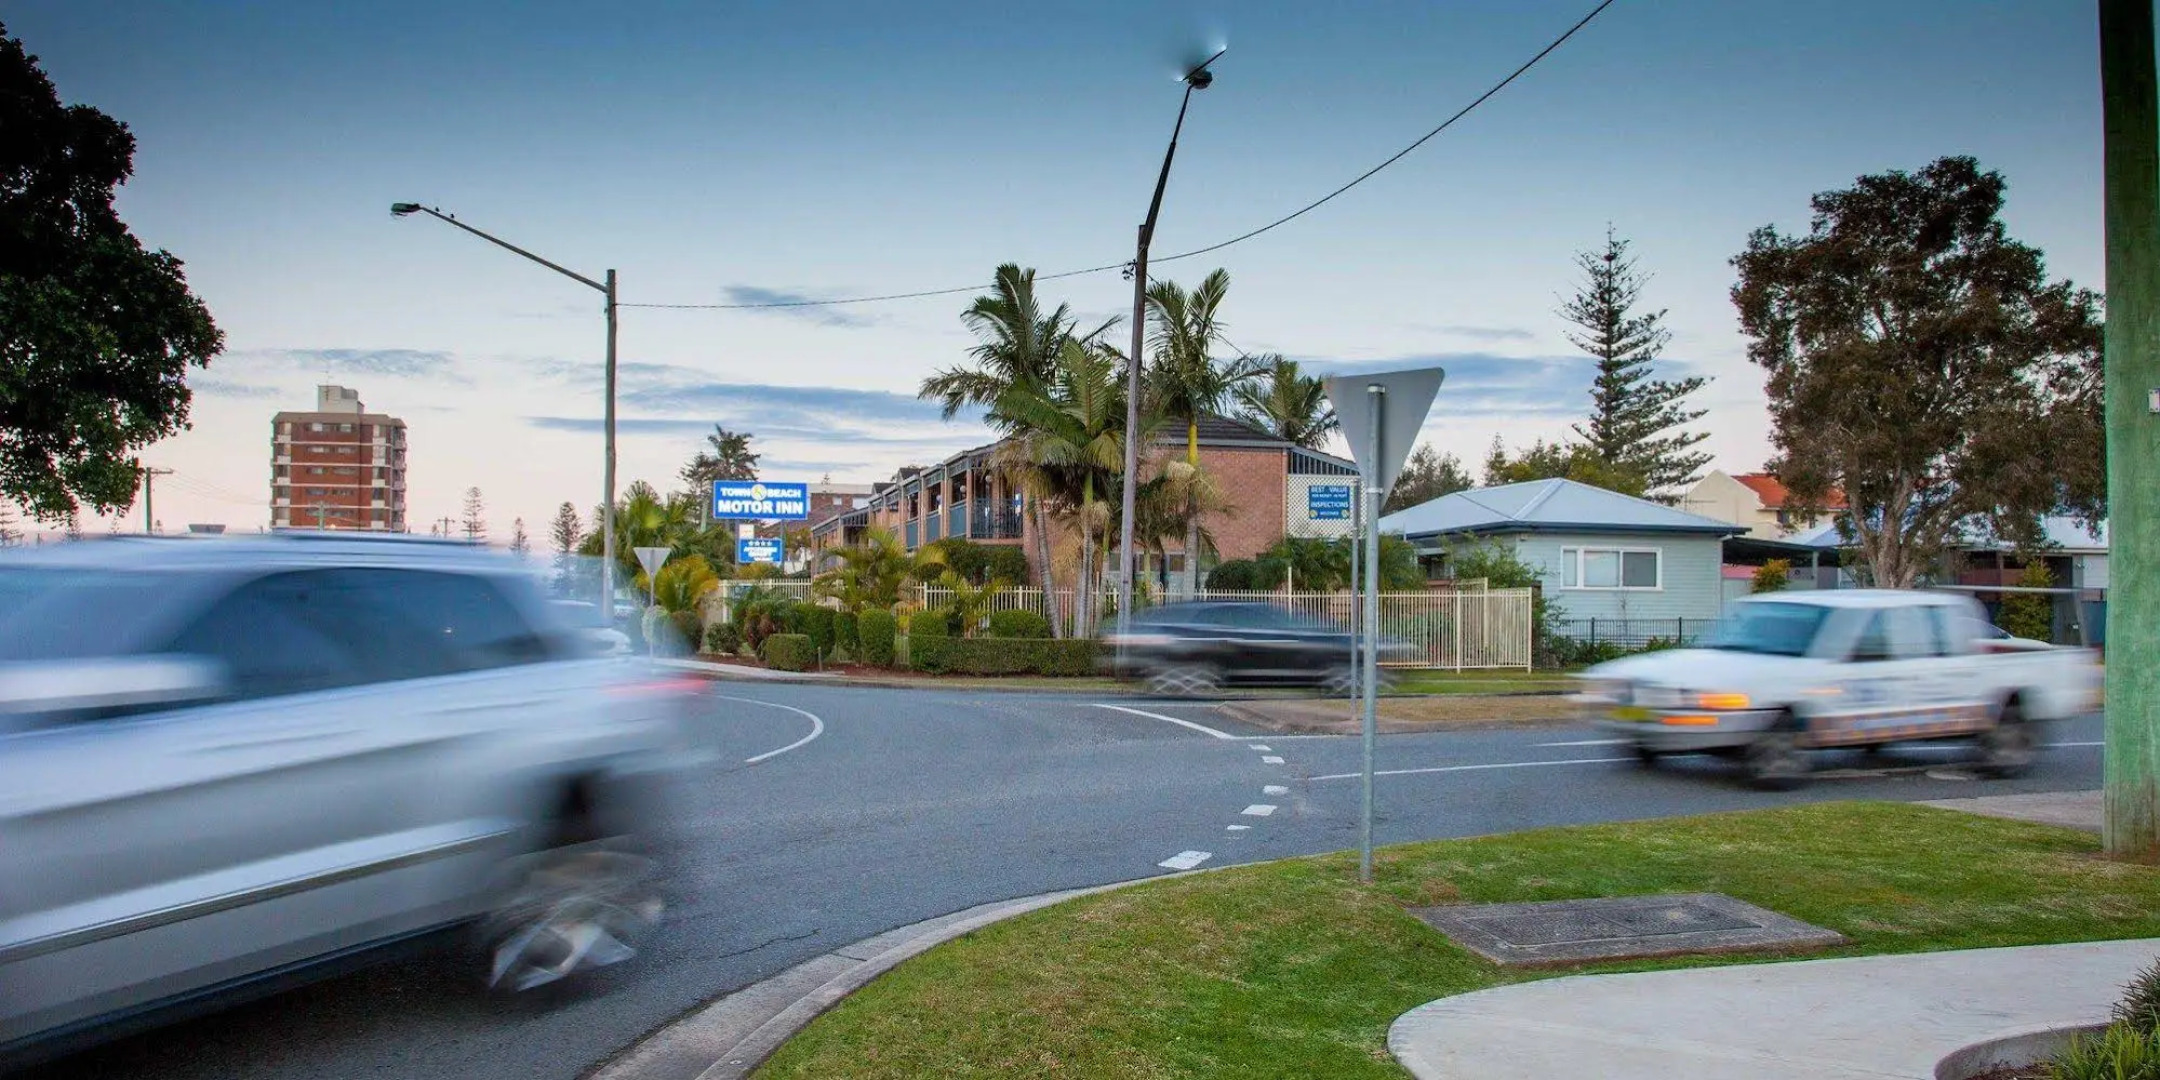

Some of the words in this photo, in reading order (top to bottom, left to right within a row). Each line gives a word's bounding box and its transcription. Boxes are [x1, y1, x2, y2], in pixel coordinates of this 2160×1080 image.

[720, 487, 751, 497] TOWN
[767, 489, 802, 498] BEACH
[718, 500, 774, 514] MOTOR
[776, 501, 804, 515] INN
